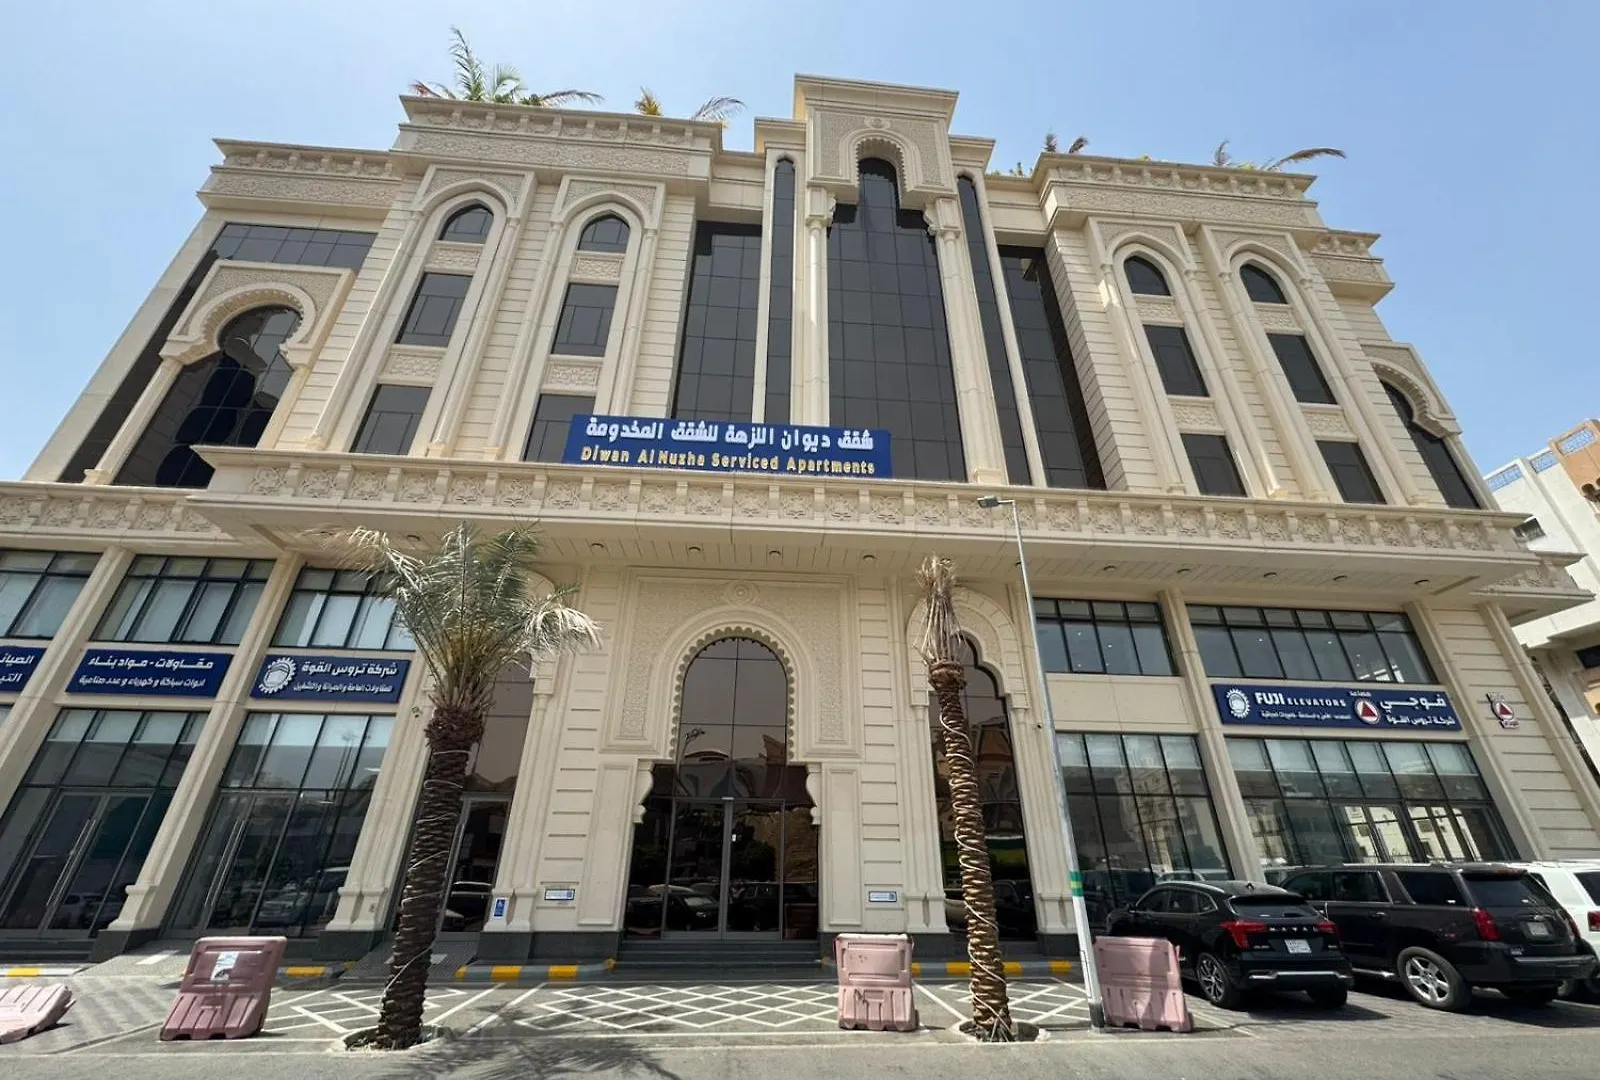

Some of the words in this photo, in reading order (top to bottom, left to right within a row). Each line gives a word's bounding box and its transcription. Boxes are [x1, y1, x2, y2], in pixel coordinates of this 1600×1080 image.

[586, 416, 664, 442] المخدومة
[671, 420, 719, 442] للشقق
[781, 429, 831, 453] ديوان
[837, 428, 874, 450] شقق
[581, 445, 630, 463] Diwan
[637, 449, 655, 464] Al
[711, 452, 779, 470] Serviced
[786, 456, 875, 475] Apartments
[88, 655, 117, 670] بناء
[118, 657, 147, 671] مواد
[154, 658, 214, 671] مقاولات
[301, 660, 331, 675] القوة
[331, 663, 365, 677] تروس
[367, 661, 397, 678] شركة
[1254, 691, 1285, 705] FUJI
[1287, 697, 1347, 708] ELEVATORS
[1380, 693, 1447, 714] فوجي
